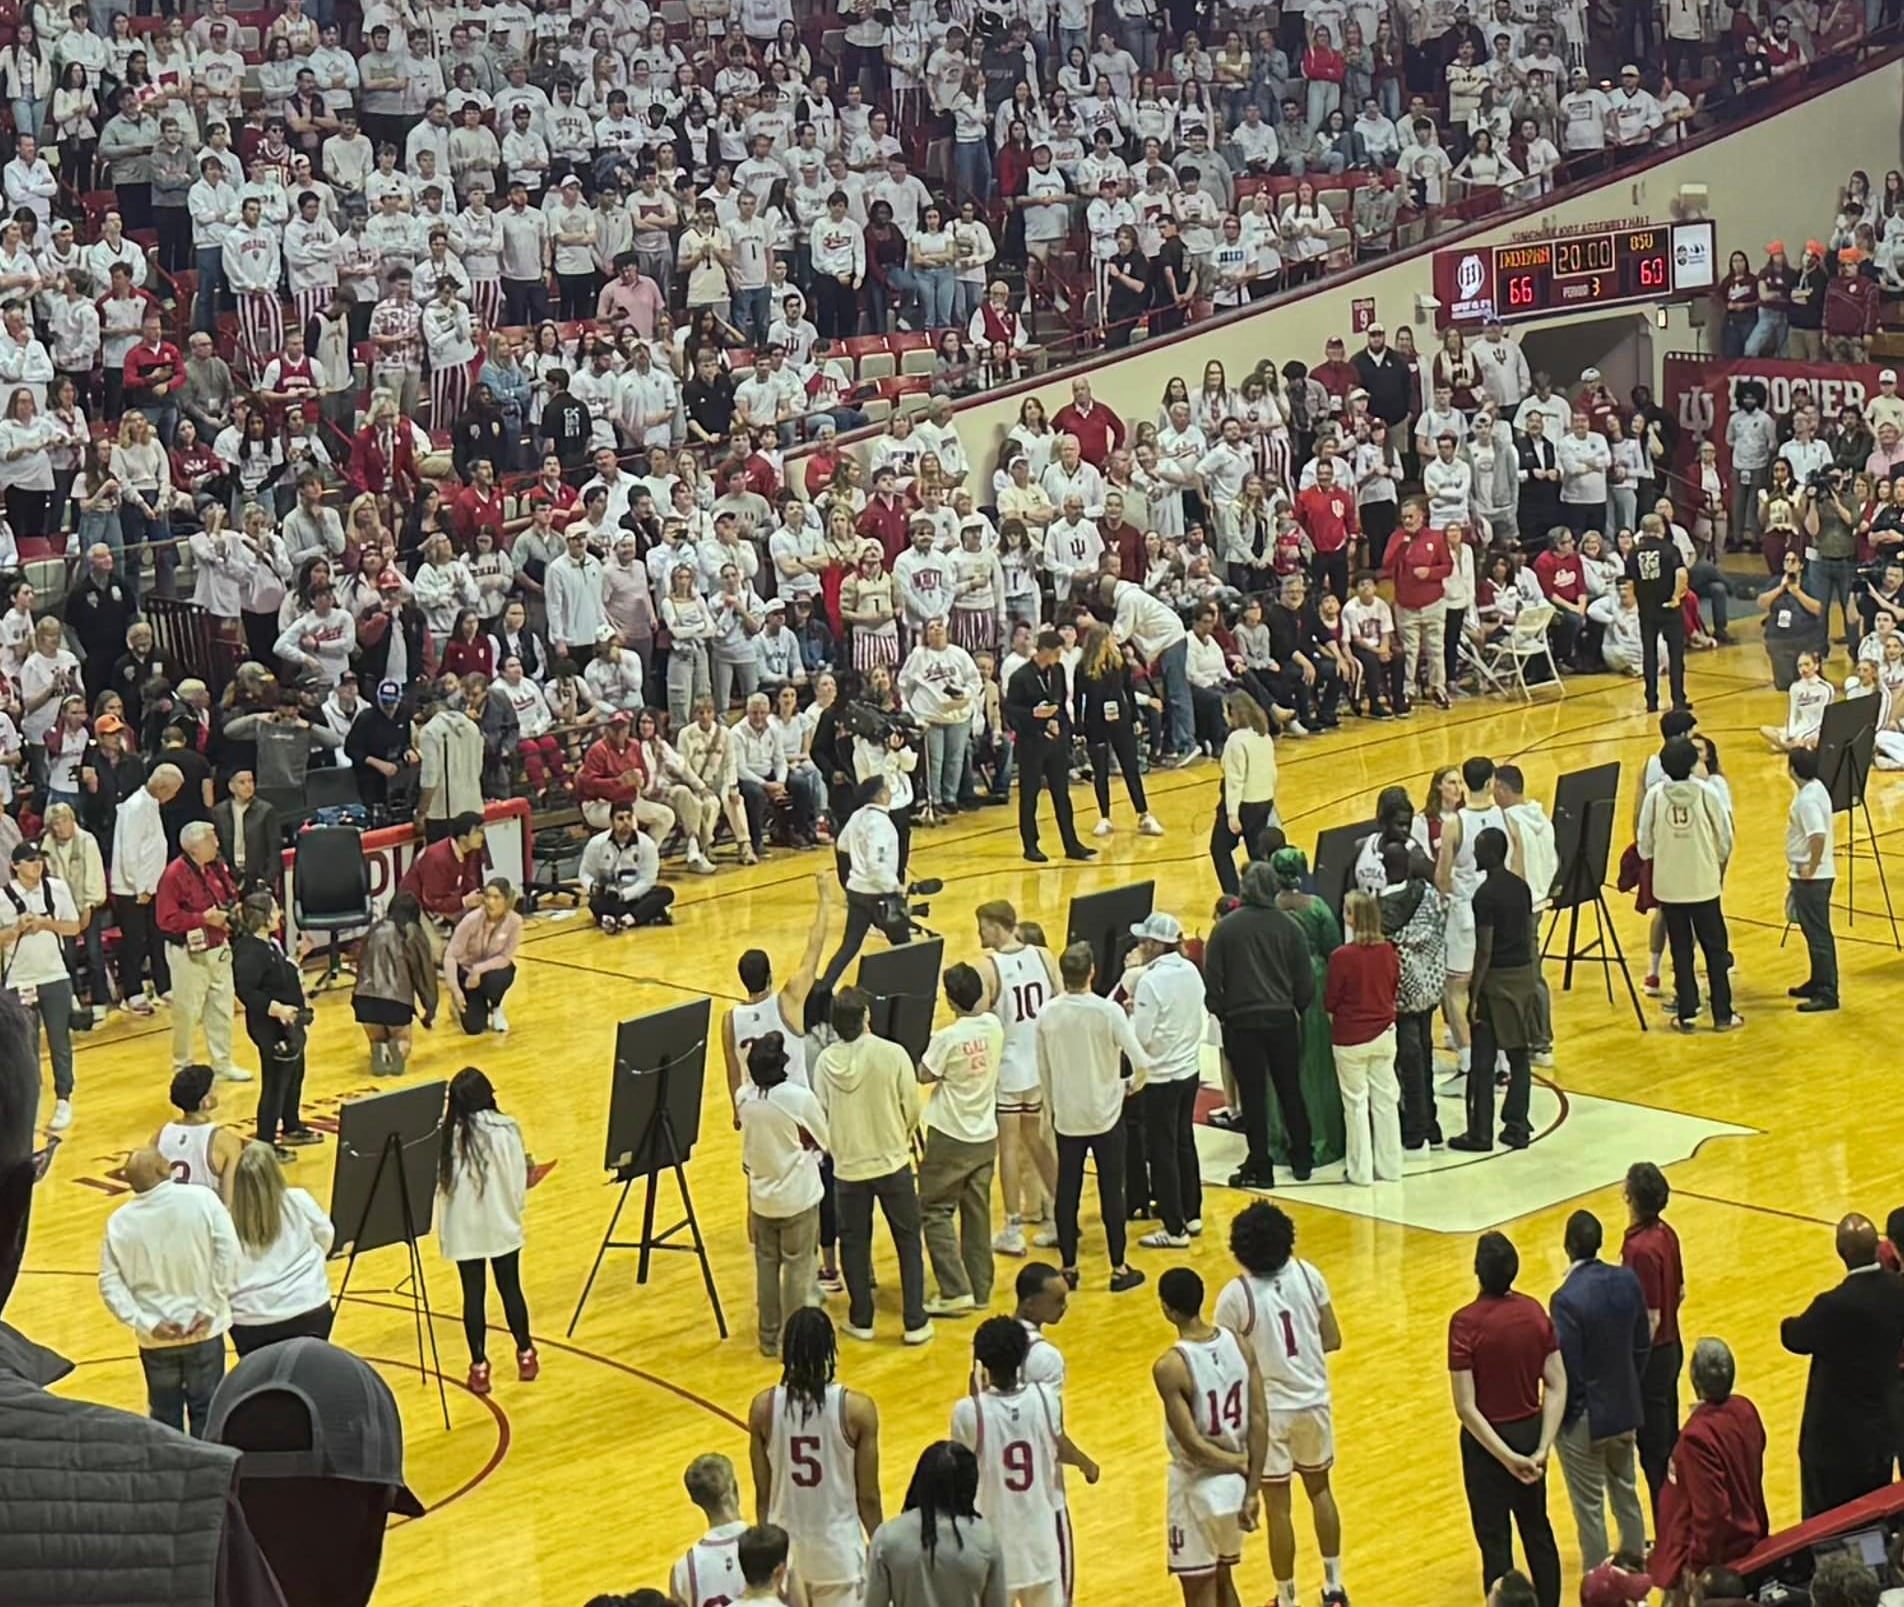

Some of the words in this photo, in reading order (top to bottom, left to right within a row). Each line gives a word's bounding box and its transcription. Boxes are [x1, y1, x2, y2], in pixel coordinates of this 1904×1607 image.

[1509, 276, 1533, 306] 66
[1640, 257, 1663, 286] 60
[1012, 981, 1043, 1023] 10
[1280, 1310, 1298, 1358] 1
[1206, 1379, 1243, 1437] 14
[791, 1435, 823, 1488] 5
[1002, 1439, 1035, 1493] 9
